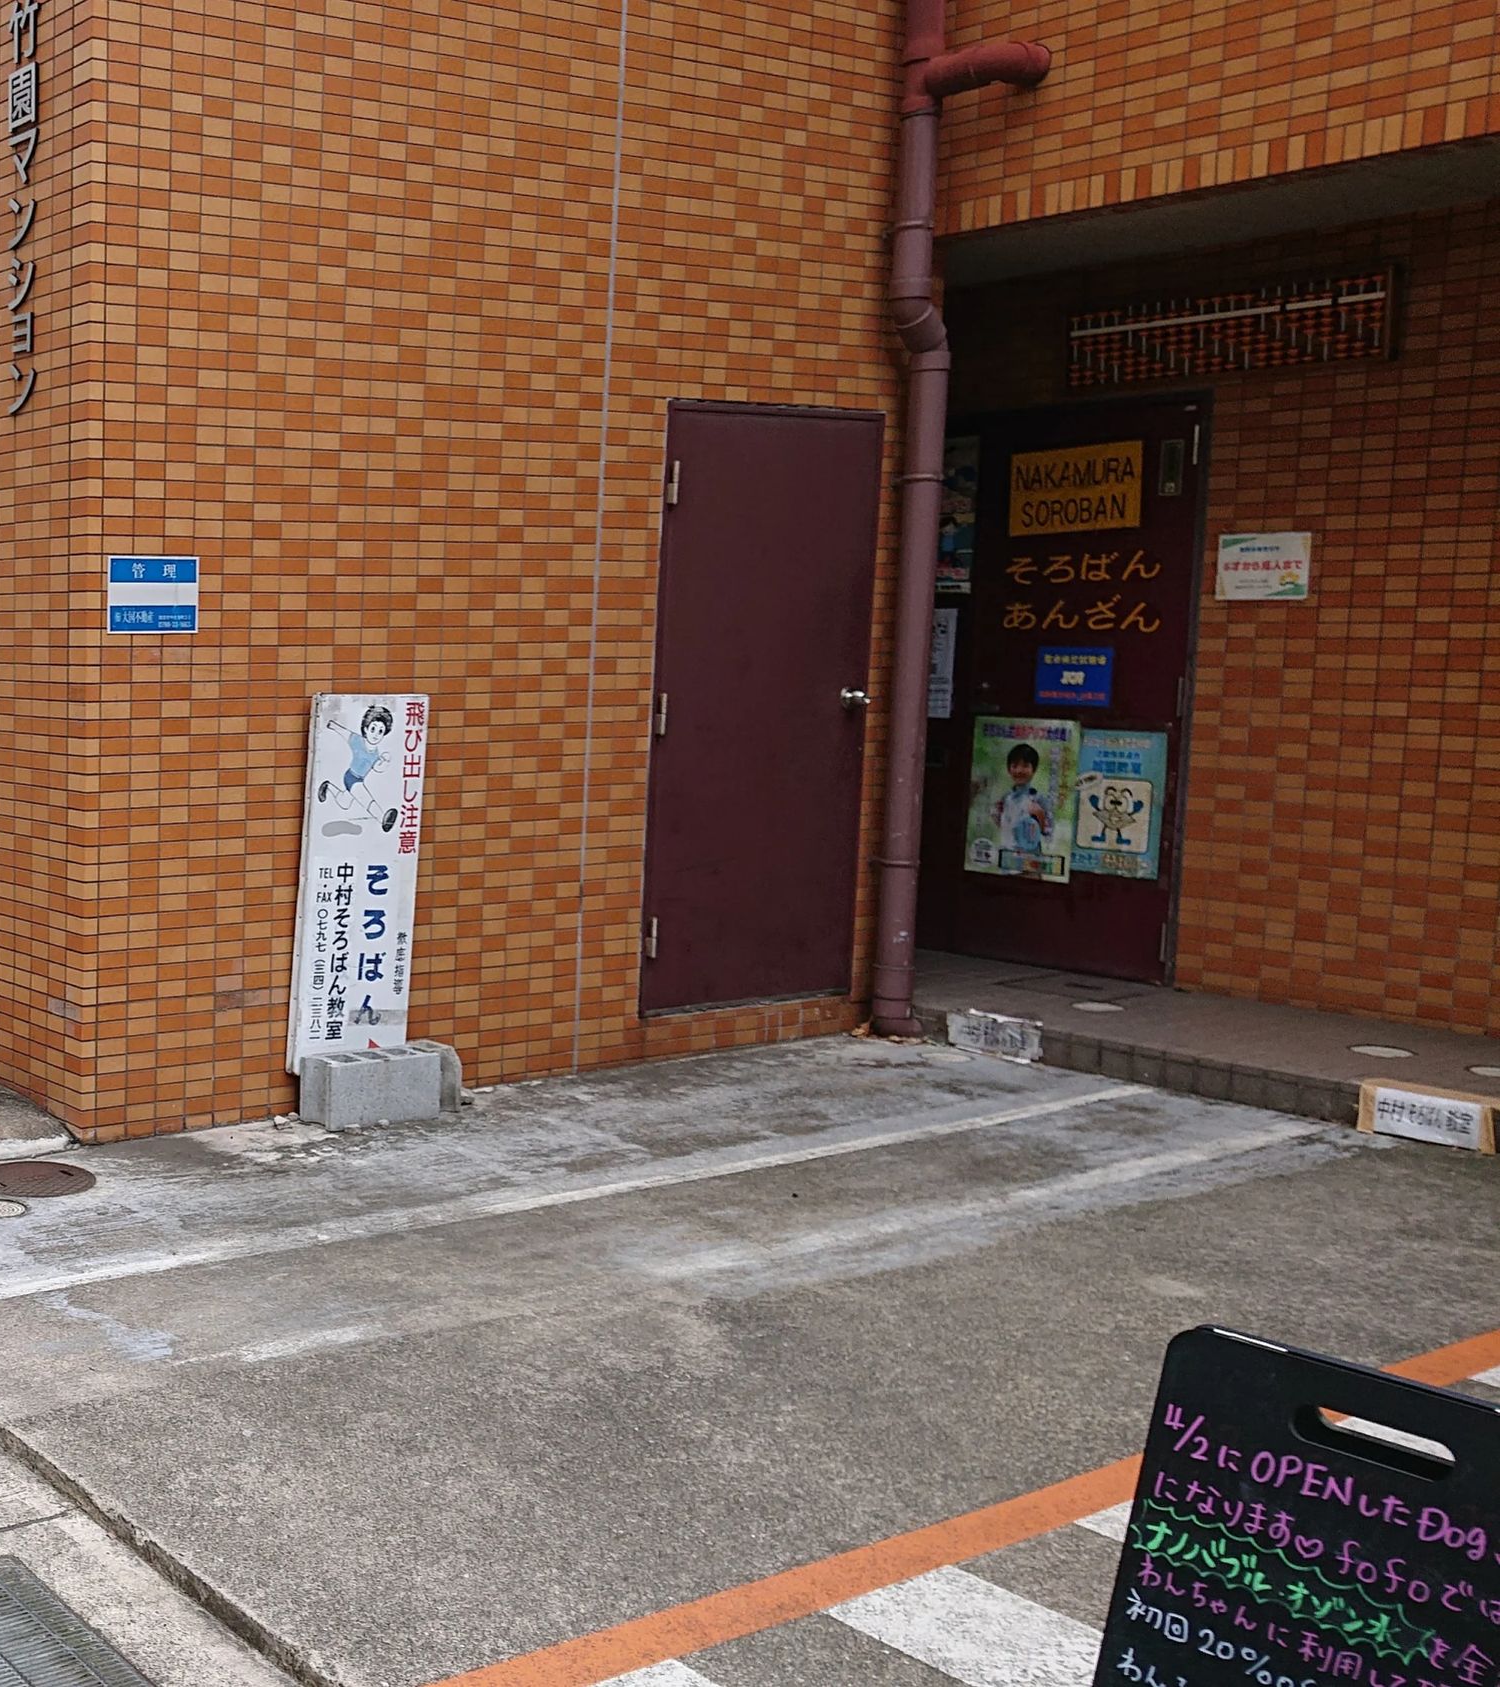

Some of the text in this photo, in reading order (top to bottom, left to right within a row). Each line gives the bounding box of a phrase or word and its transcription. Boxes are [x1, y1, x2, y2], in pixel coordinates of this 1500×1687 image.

[8, 1, 40, 415] 竹園マンション
[1015, 456, 1136, 492] NAKAMURA
[1021, 493, 1127, 528] SOROBAN
[132, 562, 177, 579] 管理
[1005, 550, 1162, 585] そろばん
[1003, 594, 1161, 633] あんざん
[398, 702, 425, 854] 飛び出し注意
[325, 863, 354, 1040] 中村そろばん教室
[354, 865, 390, 1025] そろばん
